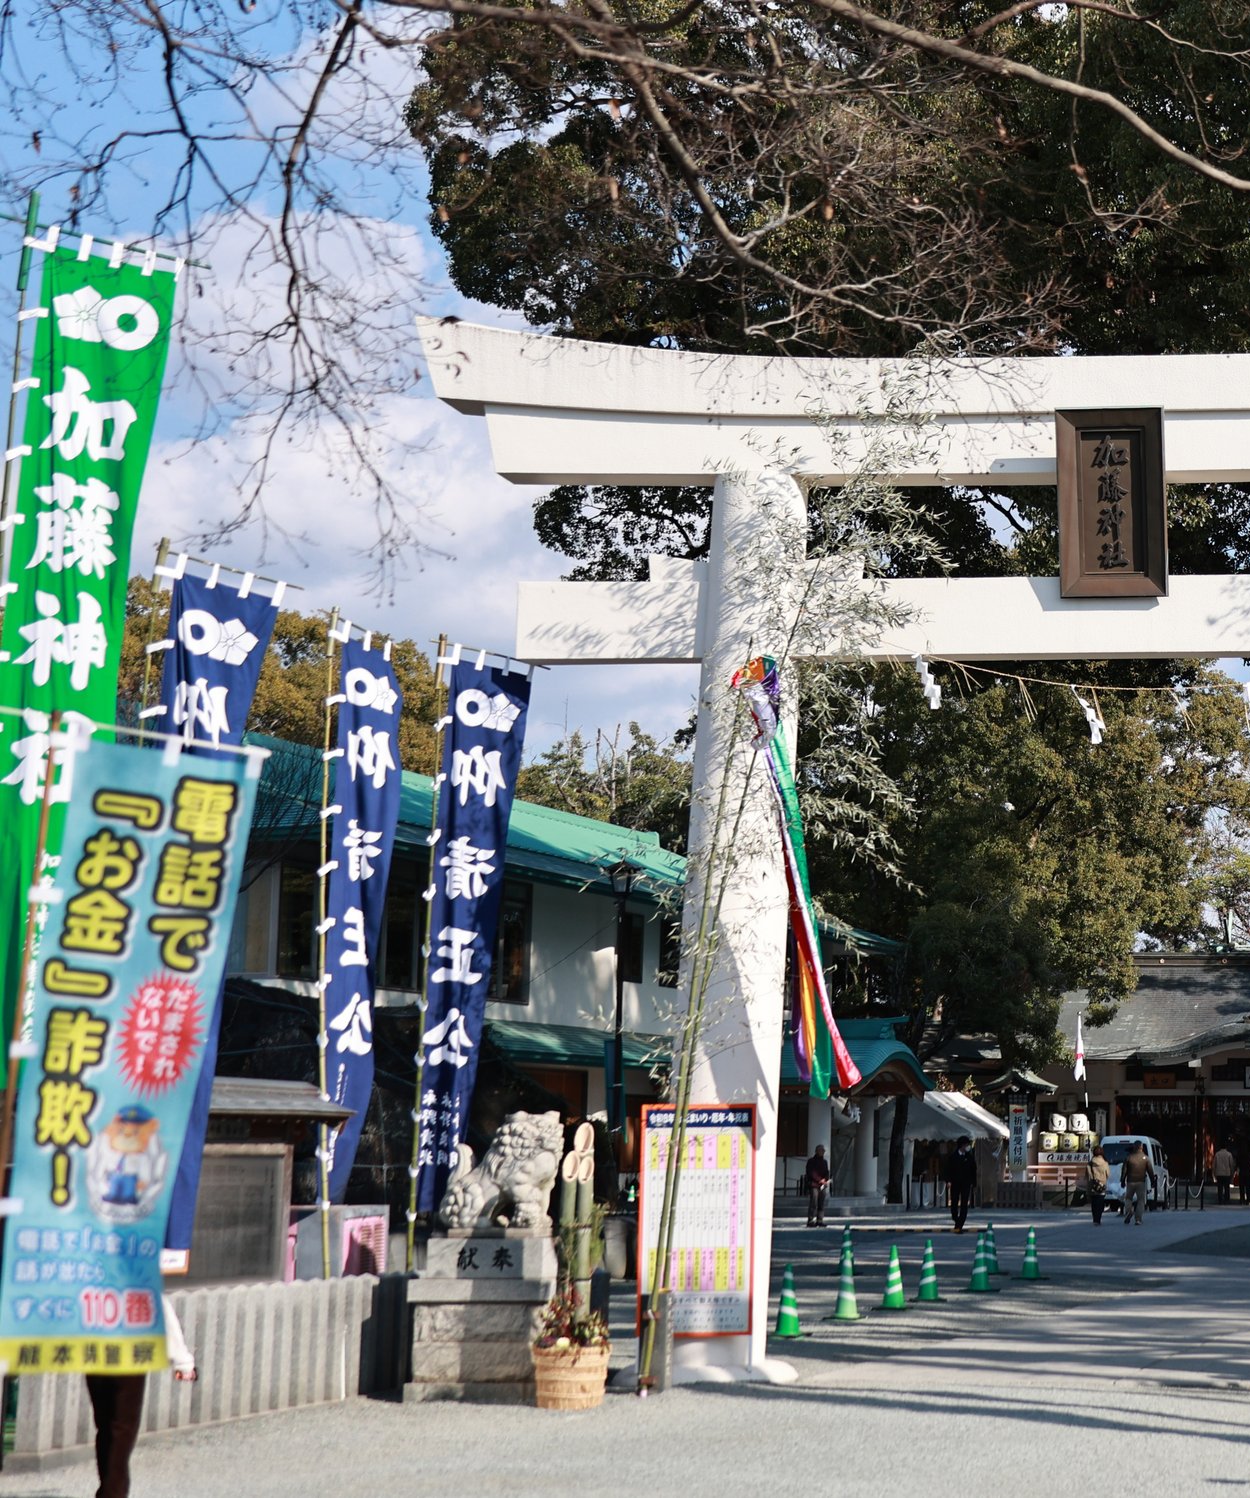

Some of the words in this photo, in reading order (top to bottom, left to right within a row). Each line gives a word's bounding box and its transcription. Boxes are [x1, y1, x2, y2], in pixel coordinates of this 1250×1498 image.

[1090, 434, 1130, 570] 加藤神社
[1, 365, 138, 806] 加藤神社
[150, 775, 239, 973] 電話で
[155, 987, 191, 1079] だまされ
[1013, 1115, 1023, 1166] 祈願受付所
[15, 1294, 74, 1320] すぐに
[80, 1288, 156, 1330] 110番
[17, 1341, 157, 1367] 熊本県警察
